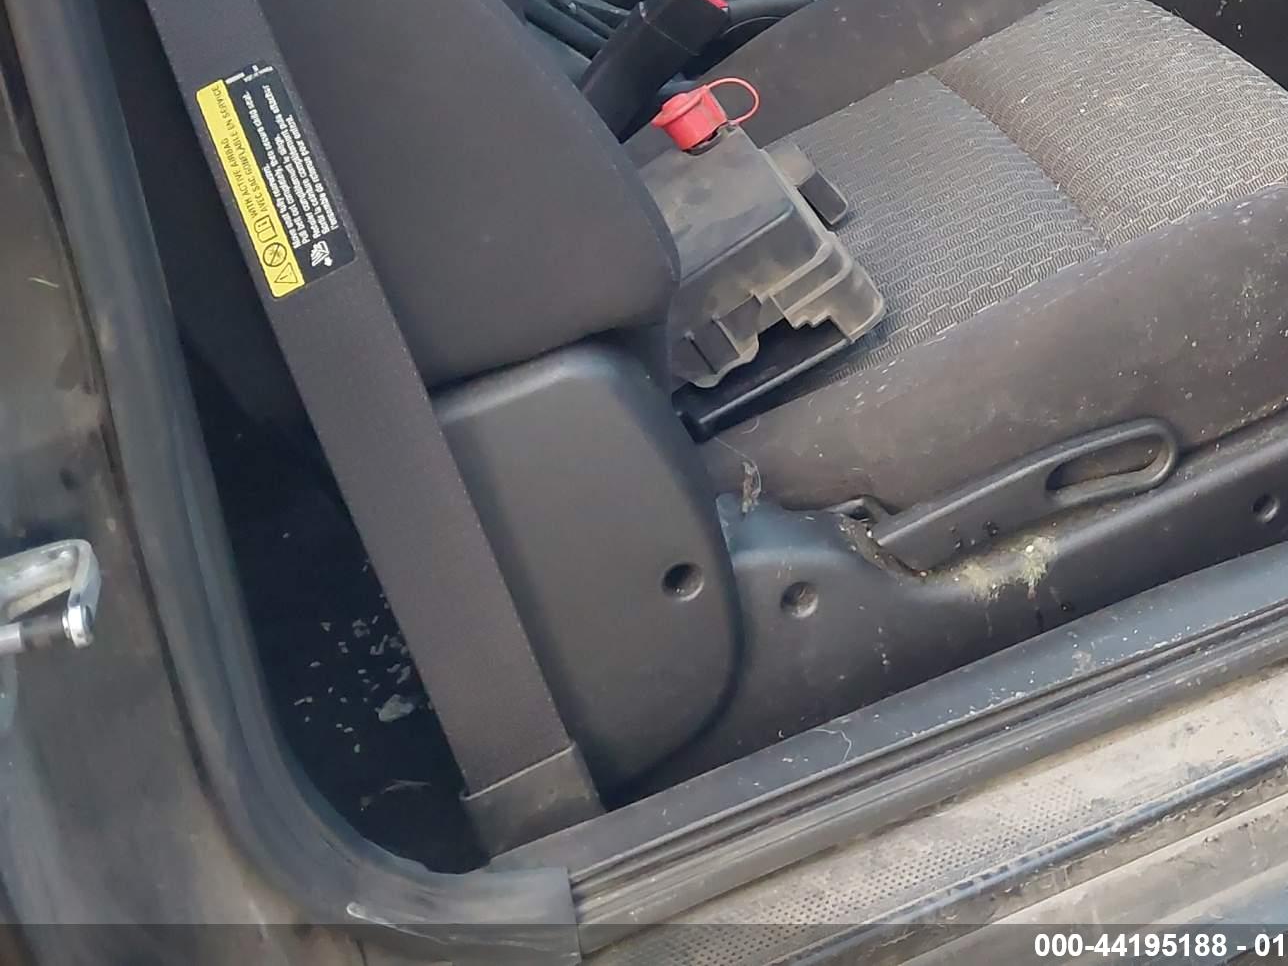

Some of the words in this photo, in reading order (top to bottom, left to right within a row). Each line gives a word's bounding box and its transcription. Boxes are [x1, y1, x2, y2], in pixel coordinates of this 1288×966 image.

[211, 85, 230, 118] SERVICE
[225, 118, 235, 130] EN
[220, 137, 238, 167] AIRBAG
[232, 169, 250, 196] ACTIVE
[247, 175, 260, 192] SAC
[244, 197, 257, 218] WITH
[254, 191, 267, 212] AVEC
